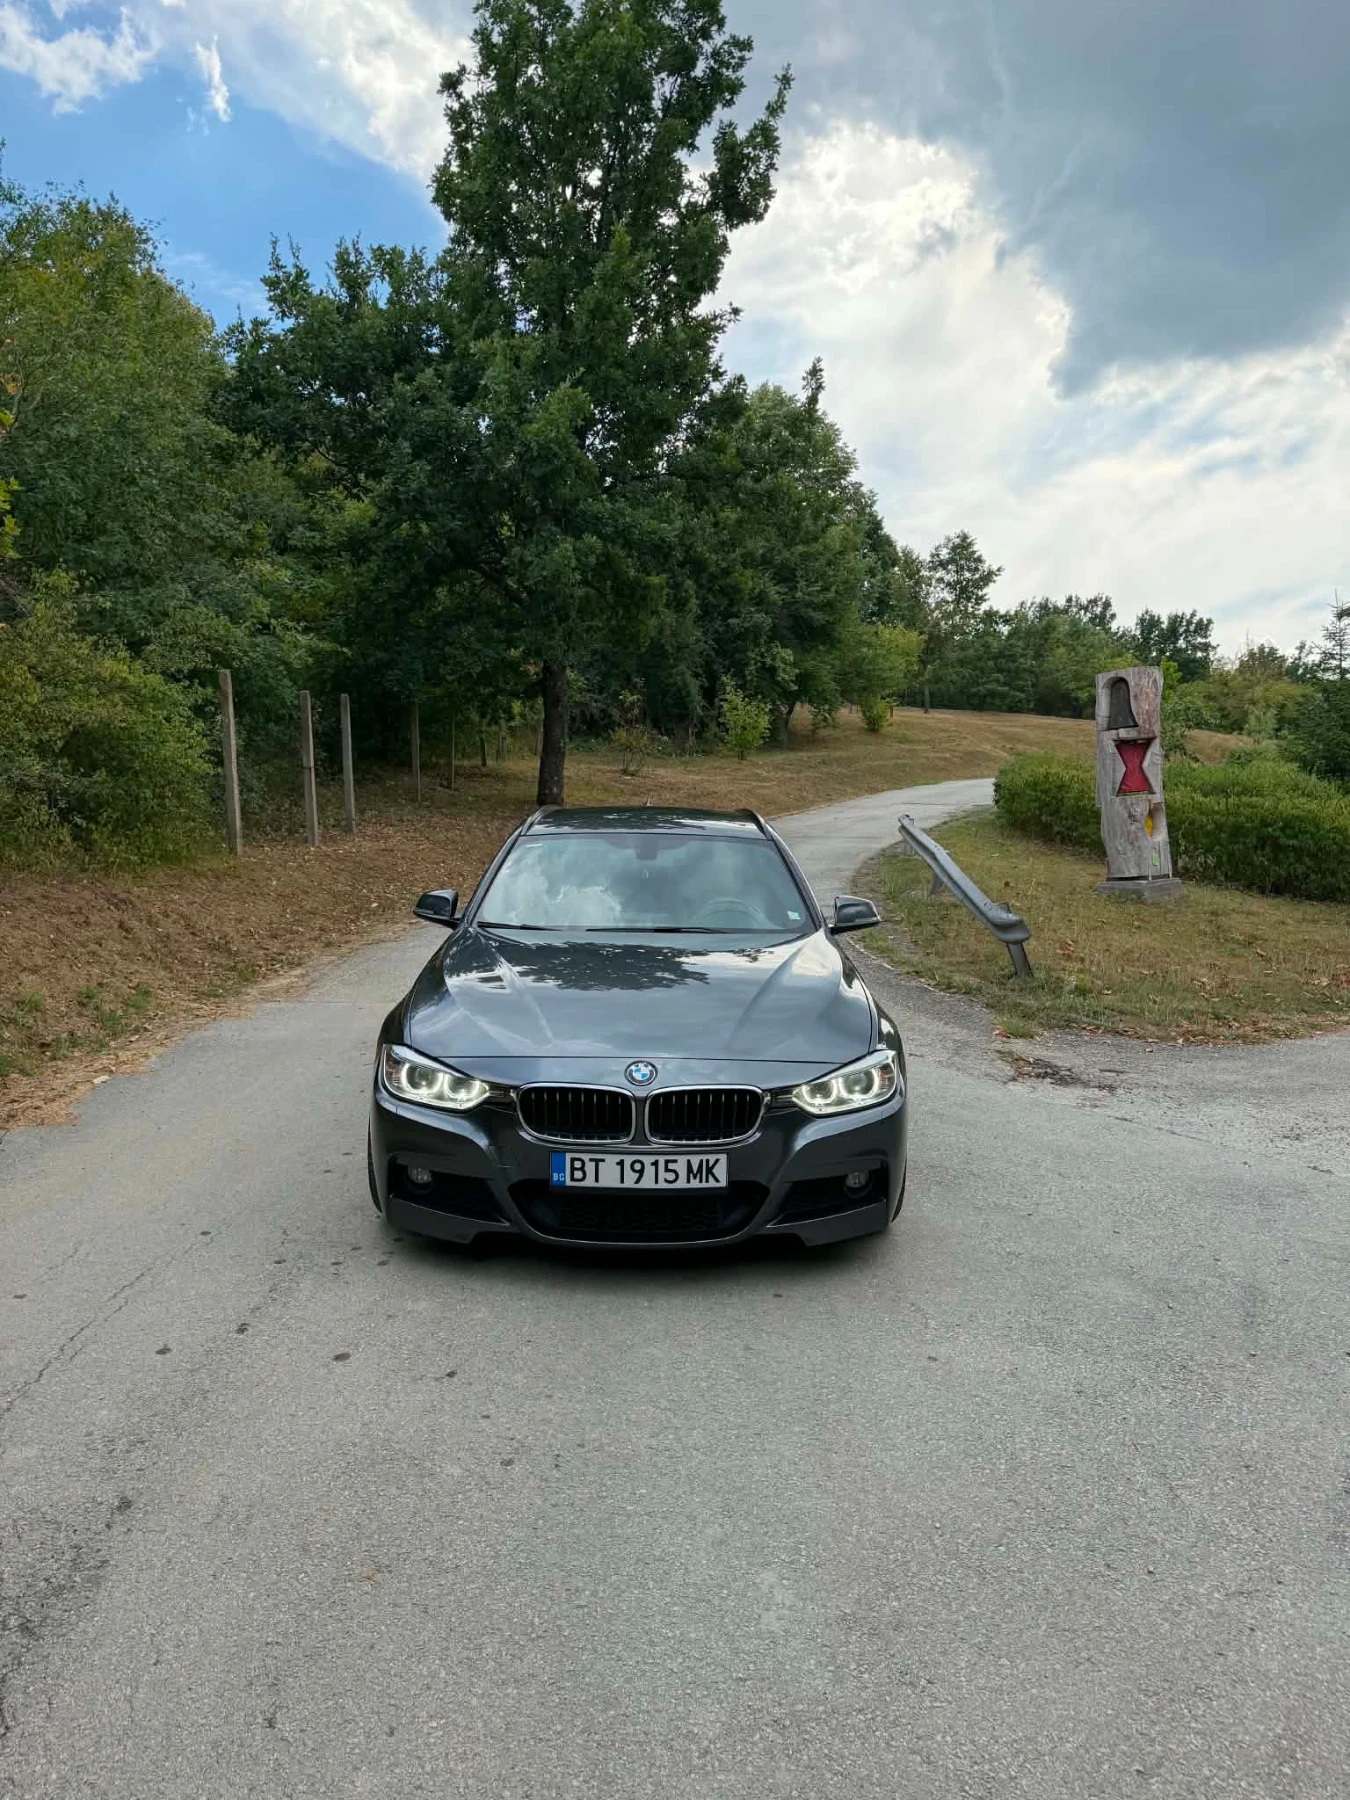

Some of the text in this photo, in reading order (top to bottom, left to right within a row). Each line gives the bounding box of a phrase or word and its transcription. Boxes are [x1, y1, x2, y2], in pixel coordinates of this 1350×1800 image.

[552, 1173, 565, 1182] BG
[569, 1157, 721, 1184] BT 1915 MK
